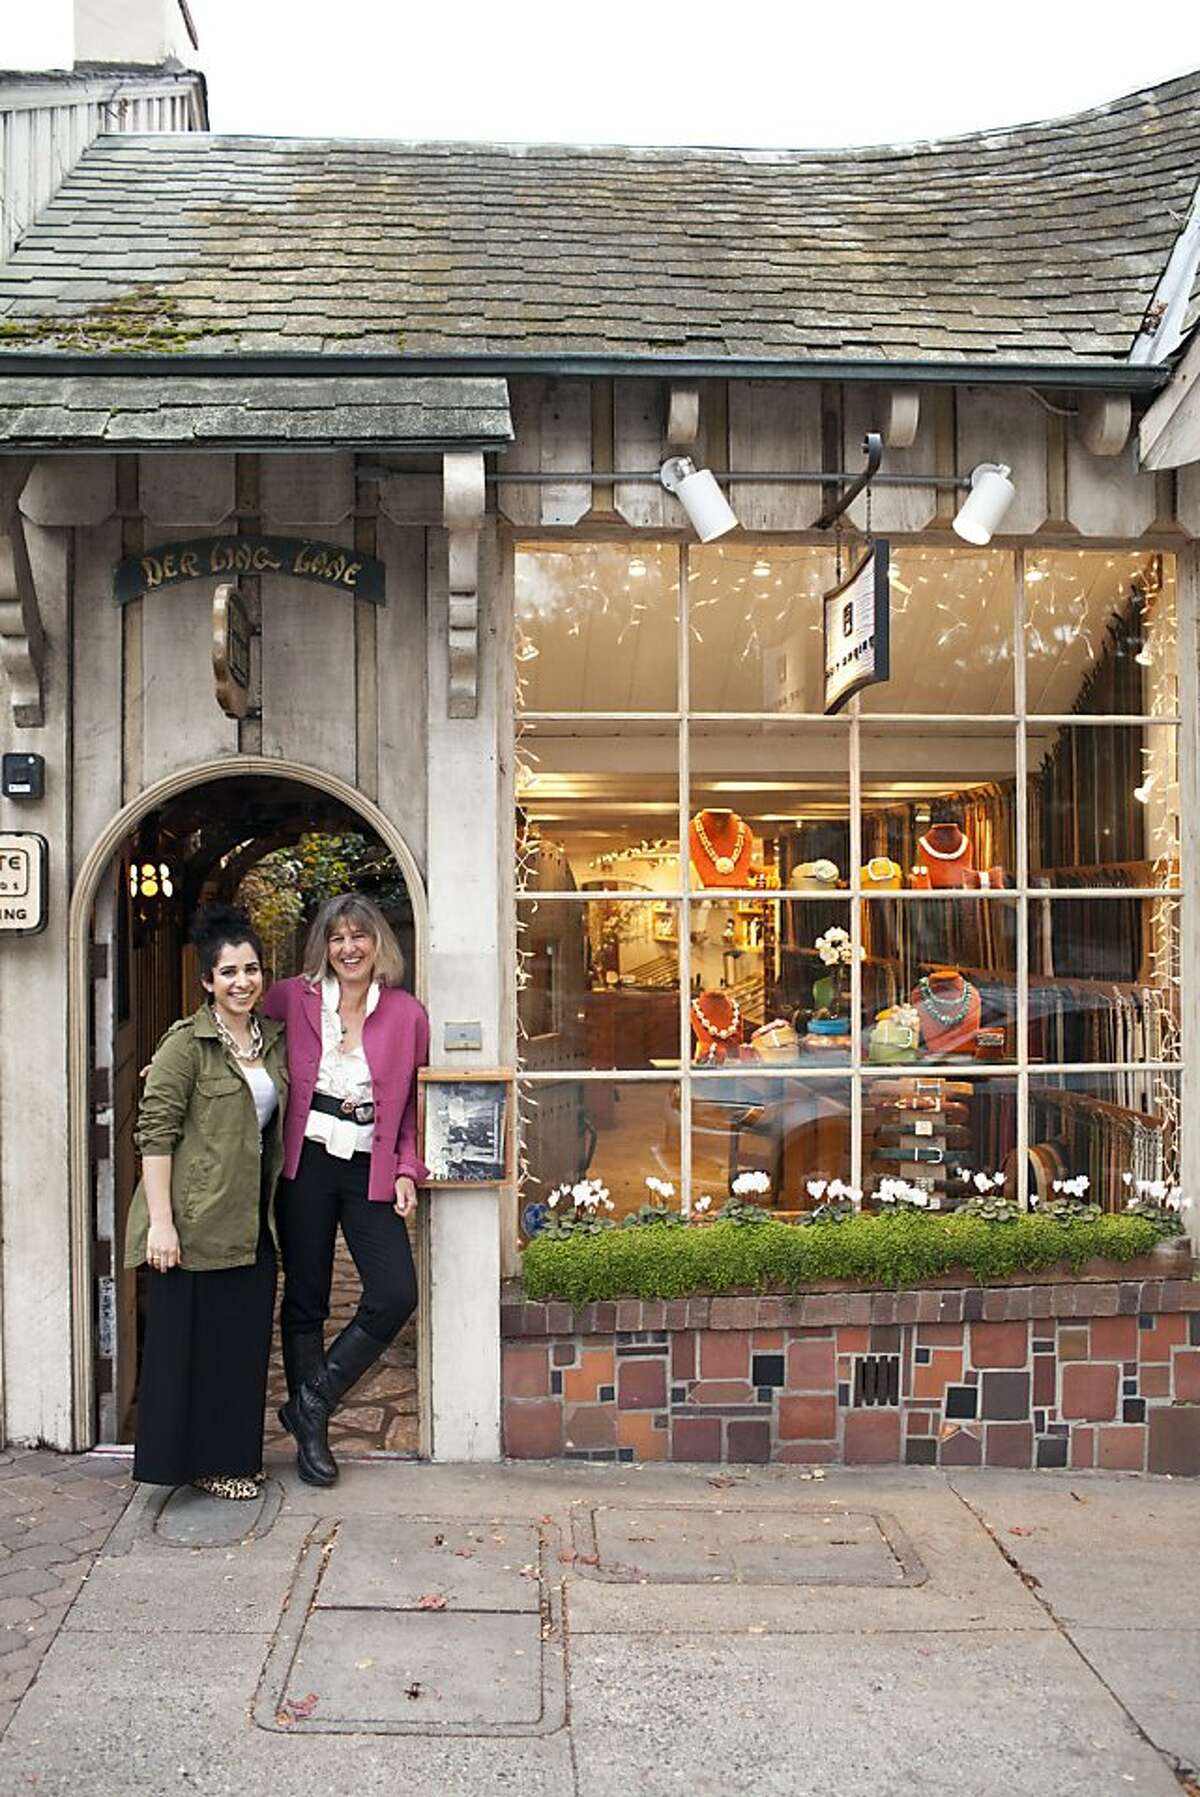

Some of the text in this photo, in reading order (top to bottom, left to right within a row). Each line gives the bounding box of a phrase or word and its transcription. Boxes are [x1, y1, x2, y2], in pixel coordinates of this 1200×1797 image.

[142, 542, 361, 586] DER LING LANE
